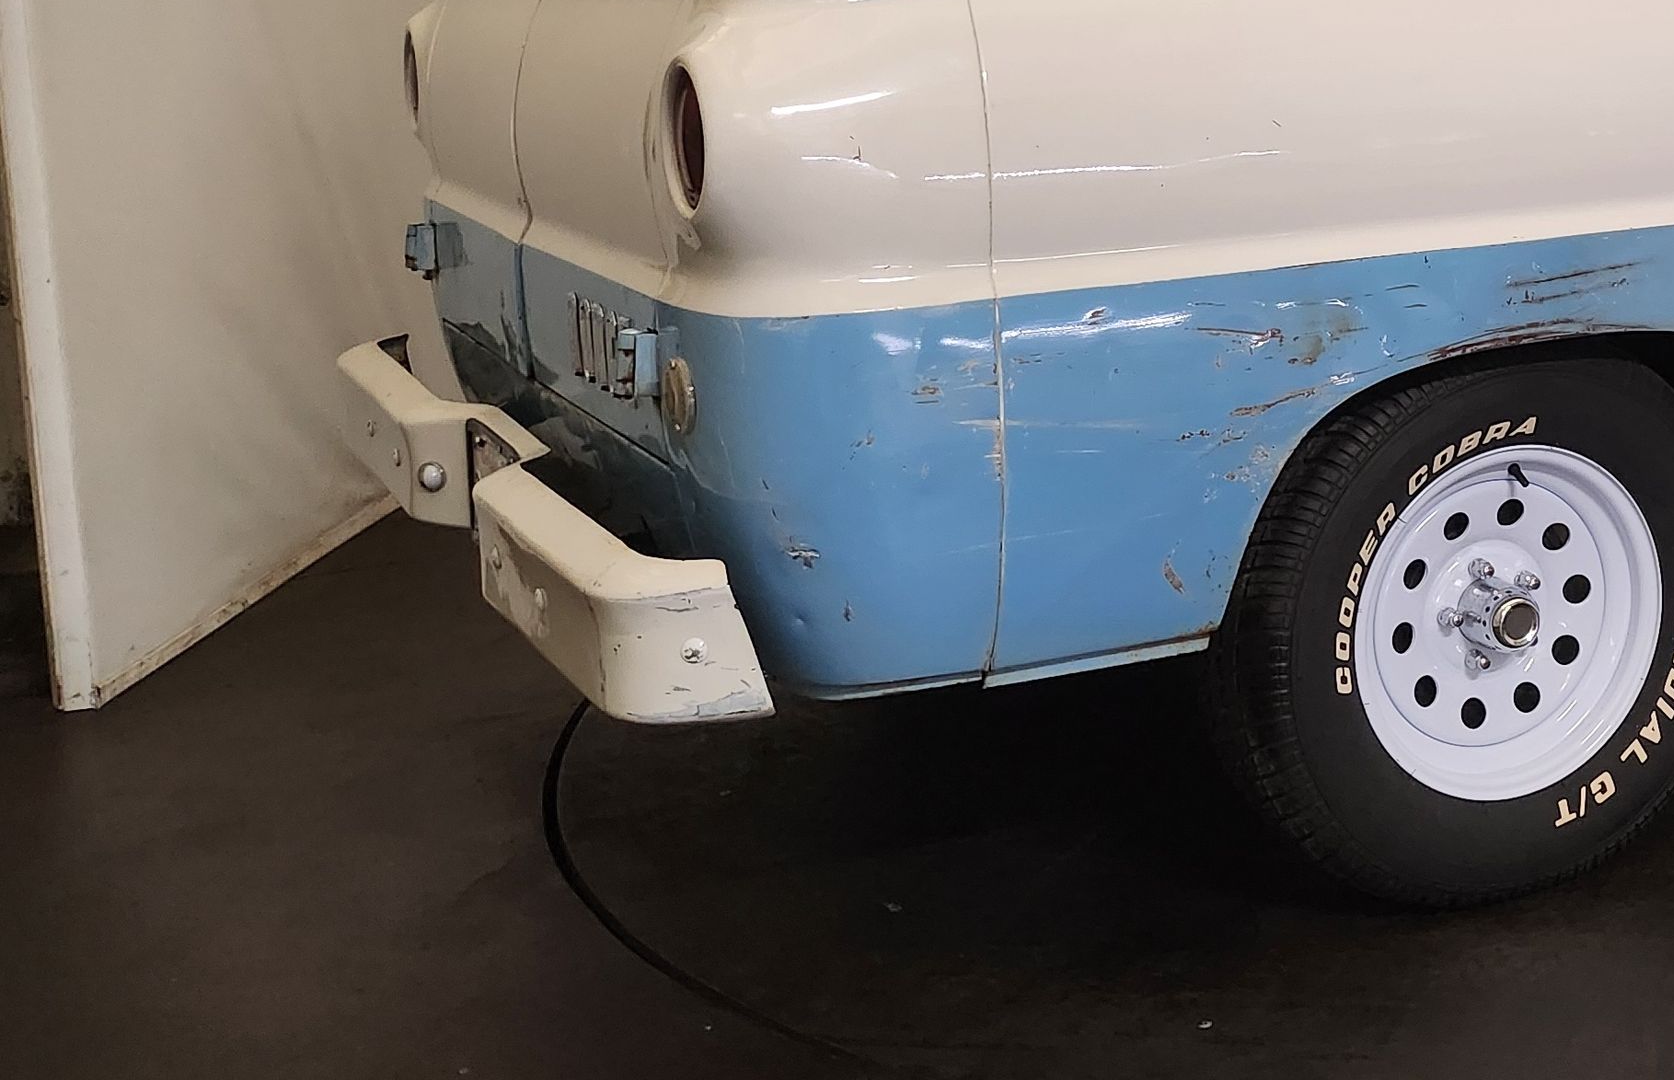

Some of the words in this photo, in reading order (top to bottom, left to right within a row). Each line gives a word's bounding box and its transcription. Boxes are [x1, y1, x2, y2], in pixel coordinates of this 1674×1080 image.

[1335, 502, 1397, 695] COOPER
[1407, 416, 1538, 495] COBRA
[1554, 771, 1616, 828] G/T
